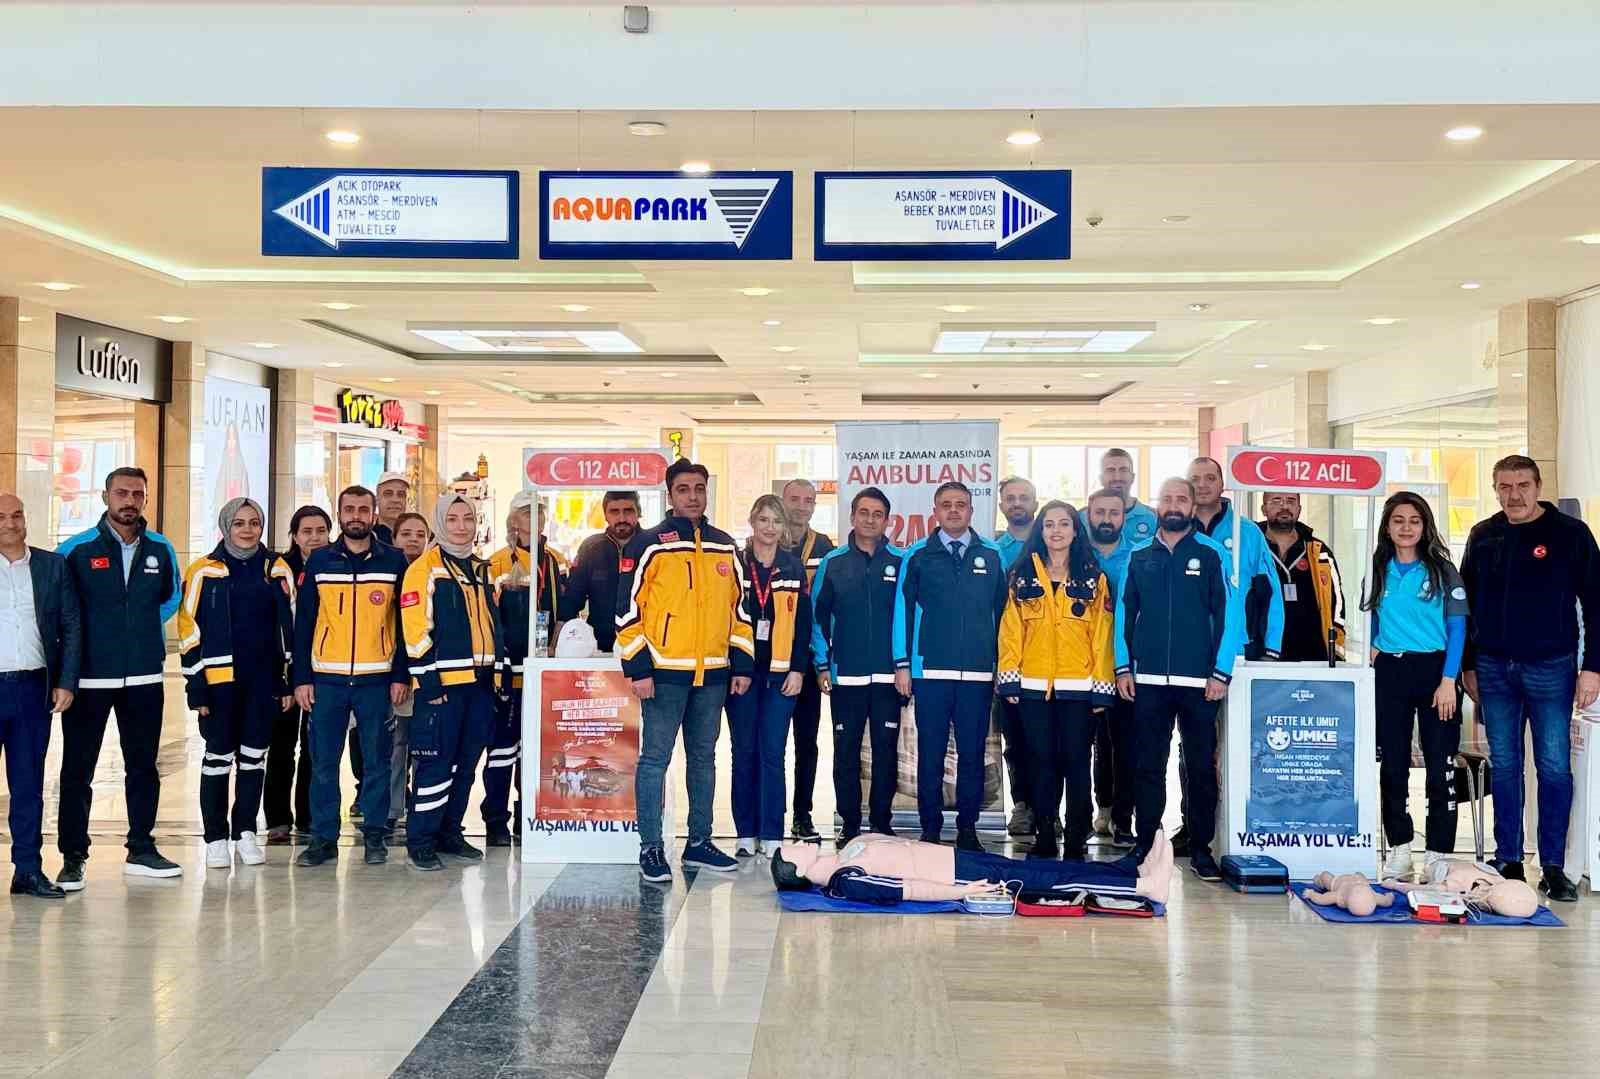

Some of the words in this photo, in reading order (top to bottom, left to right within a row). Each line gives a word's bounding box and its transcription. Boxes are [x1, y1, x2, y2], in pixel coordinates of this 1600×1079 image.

[337, 180, 358, 192] AÇIK
[361, 180, 401, 191] OTOPARK
[337, 194, 380, 206] ASANSÖR
[391, 193, 438, 207] MERDİVEN
[895, 188, 937, 202] ASANSÖR
[949, 189, 996, 202] MERDİVEN
[337, 209, 356, 220] ATM
[368, 208, 401, 221] MESCİD
[553, 197, 707, 222] AQUAPARK
[904, 205, 934, 216] BEBEK
[938, 206, 966, 216] BAKIM
[969, 205, 996, 216] ODASI
[337, 224, 396, 235] TUVALETLER
[935, 219, 996, 231] TUVALETLER
[79, 335, 141, 385] Lufian
[845, 450, 879, 462] YAŞAM
[899, 450, 936, 460] ZAMAN
[939, 449, 991, 459] ARASINDA
[577, 460, 602, 479] 112
[608, 457, 646, 479] ACİL
[847, 463, 992, 485] AMBULANS
[1285, 460, 1310, 480] 112
[1316, 460, 1357, 482] ACİL
[1266, 715, 1297, 726] AFETTE
[1316, 716, 1339, 727] UMUT
[1292, 730, 1337, 742] UMKE
[527, 818, 588, 836] YAŞAMA
[591, 819, 618, 832] YOL
[1237, 832, 1300, 851] YAŞAMA
[1303, 833, 1333, 847] YOL
